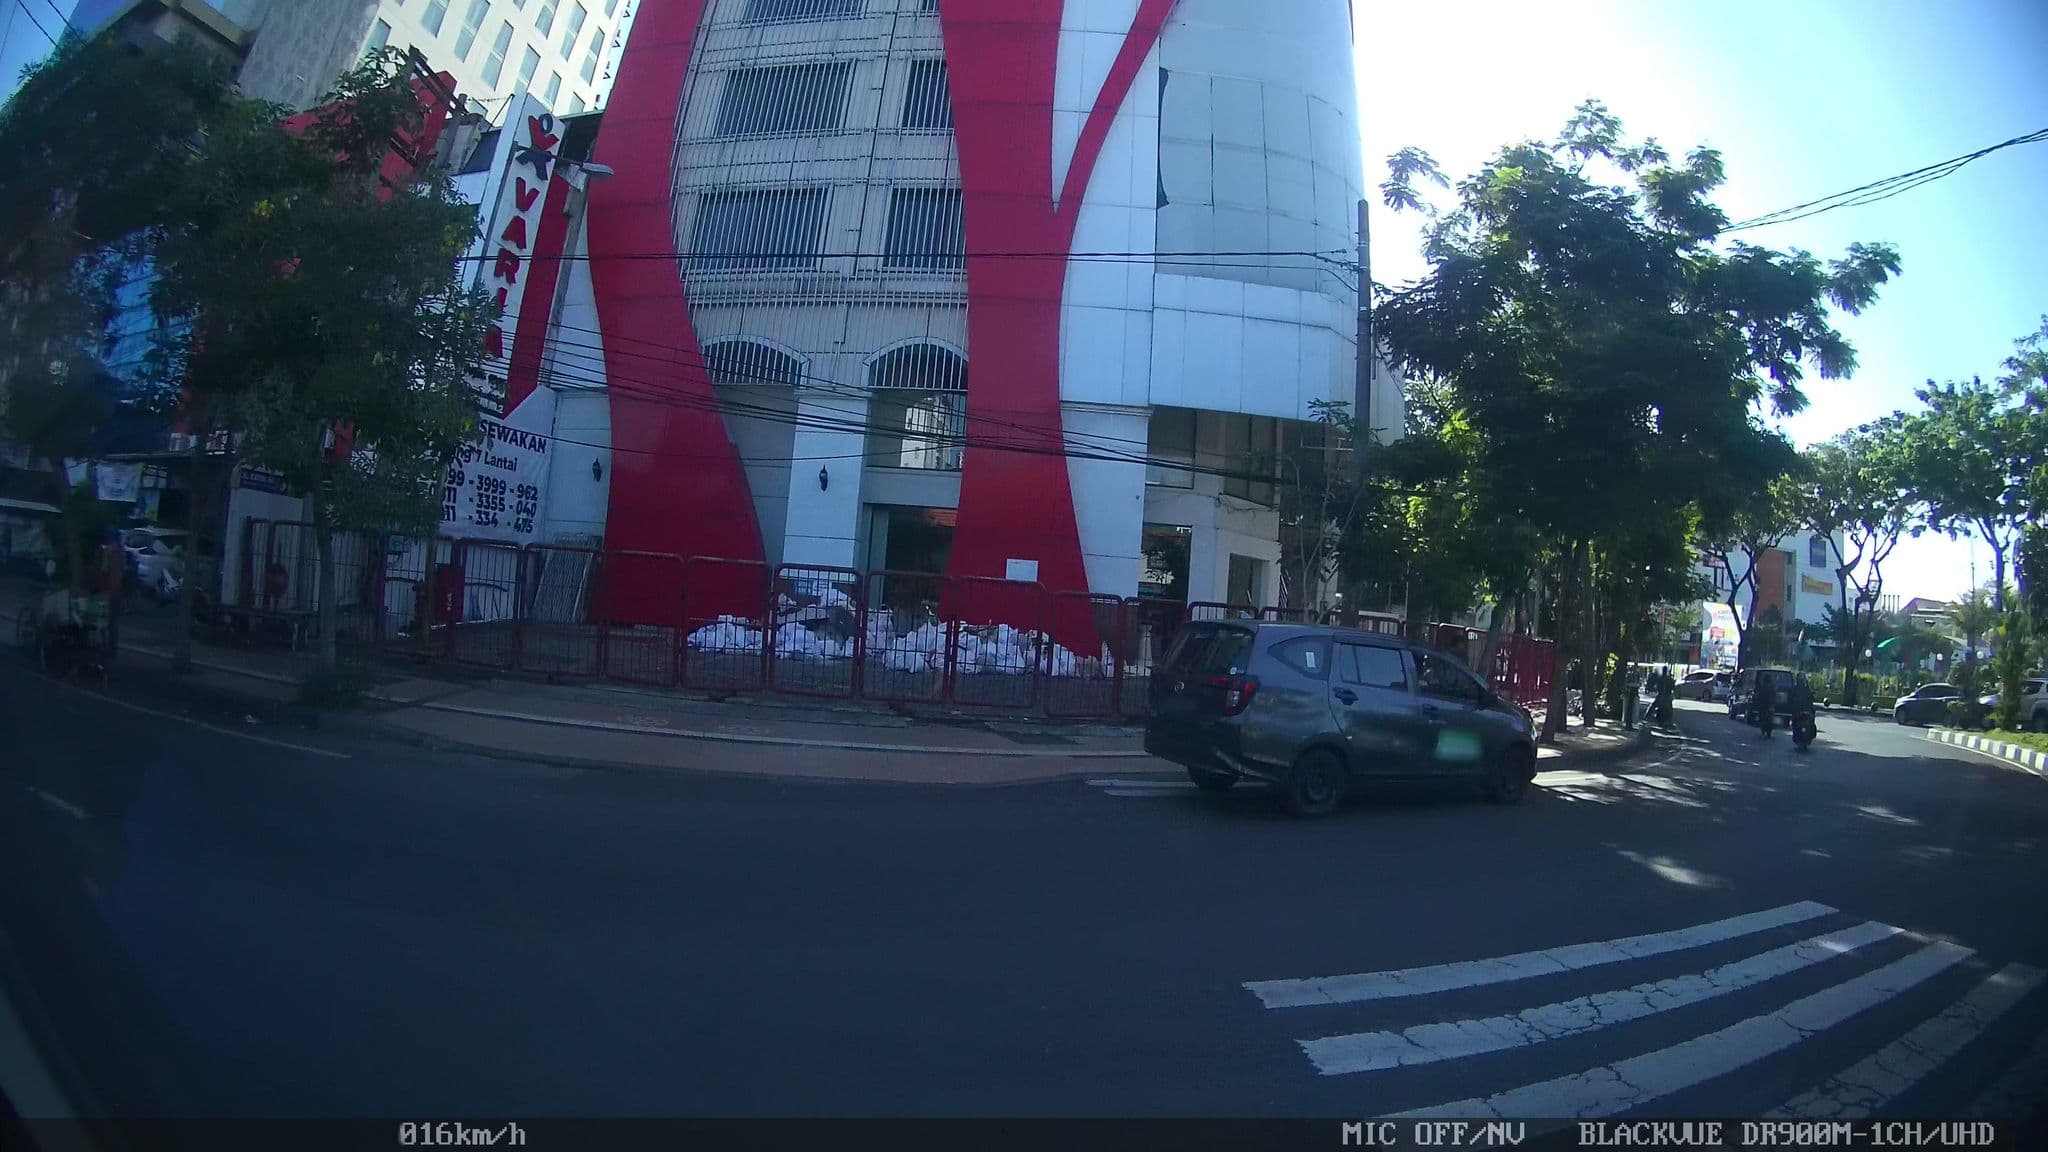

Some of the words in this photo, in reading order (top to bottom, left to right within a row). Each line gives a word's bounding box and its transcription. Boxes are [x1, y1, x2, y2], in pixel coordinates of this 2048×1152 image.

[479, 419, 547, 454] SEWAKAN
[484, 451, 518, 472] Lantai
[476, 474, 507, 495] 3999
